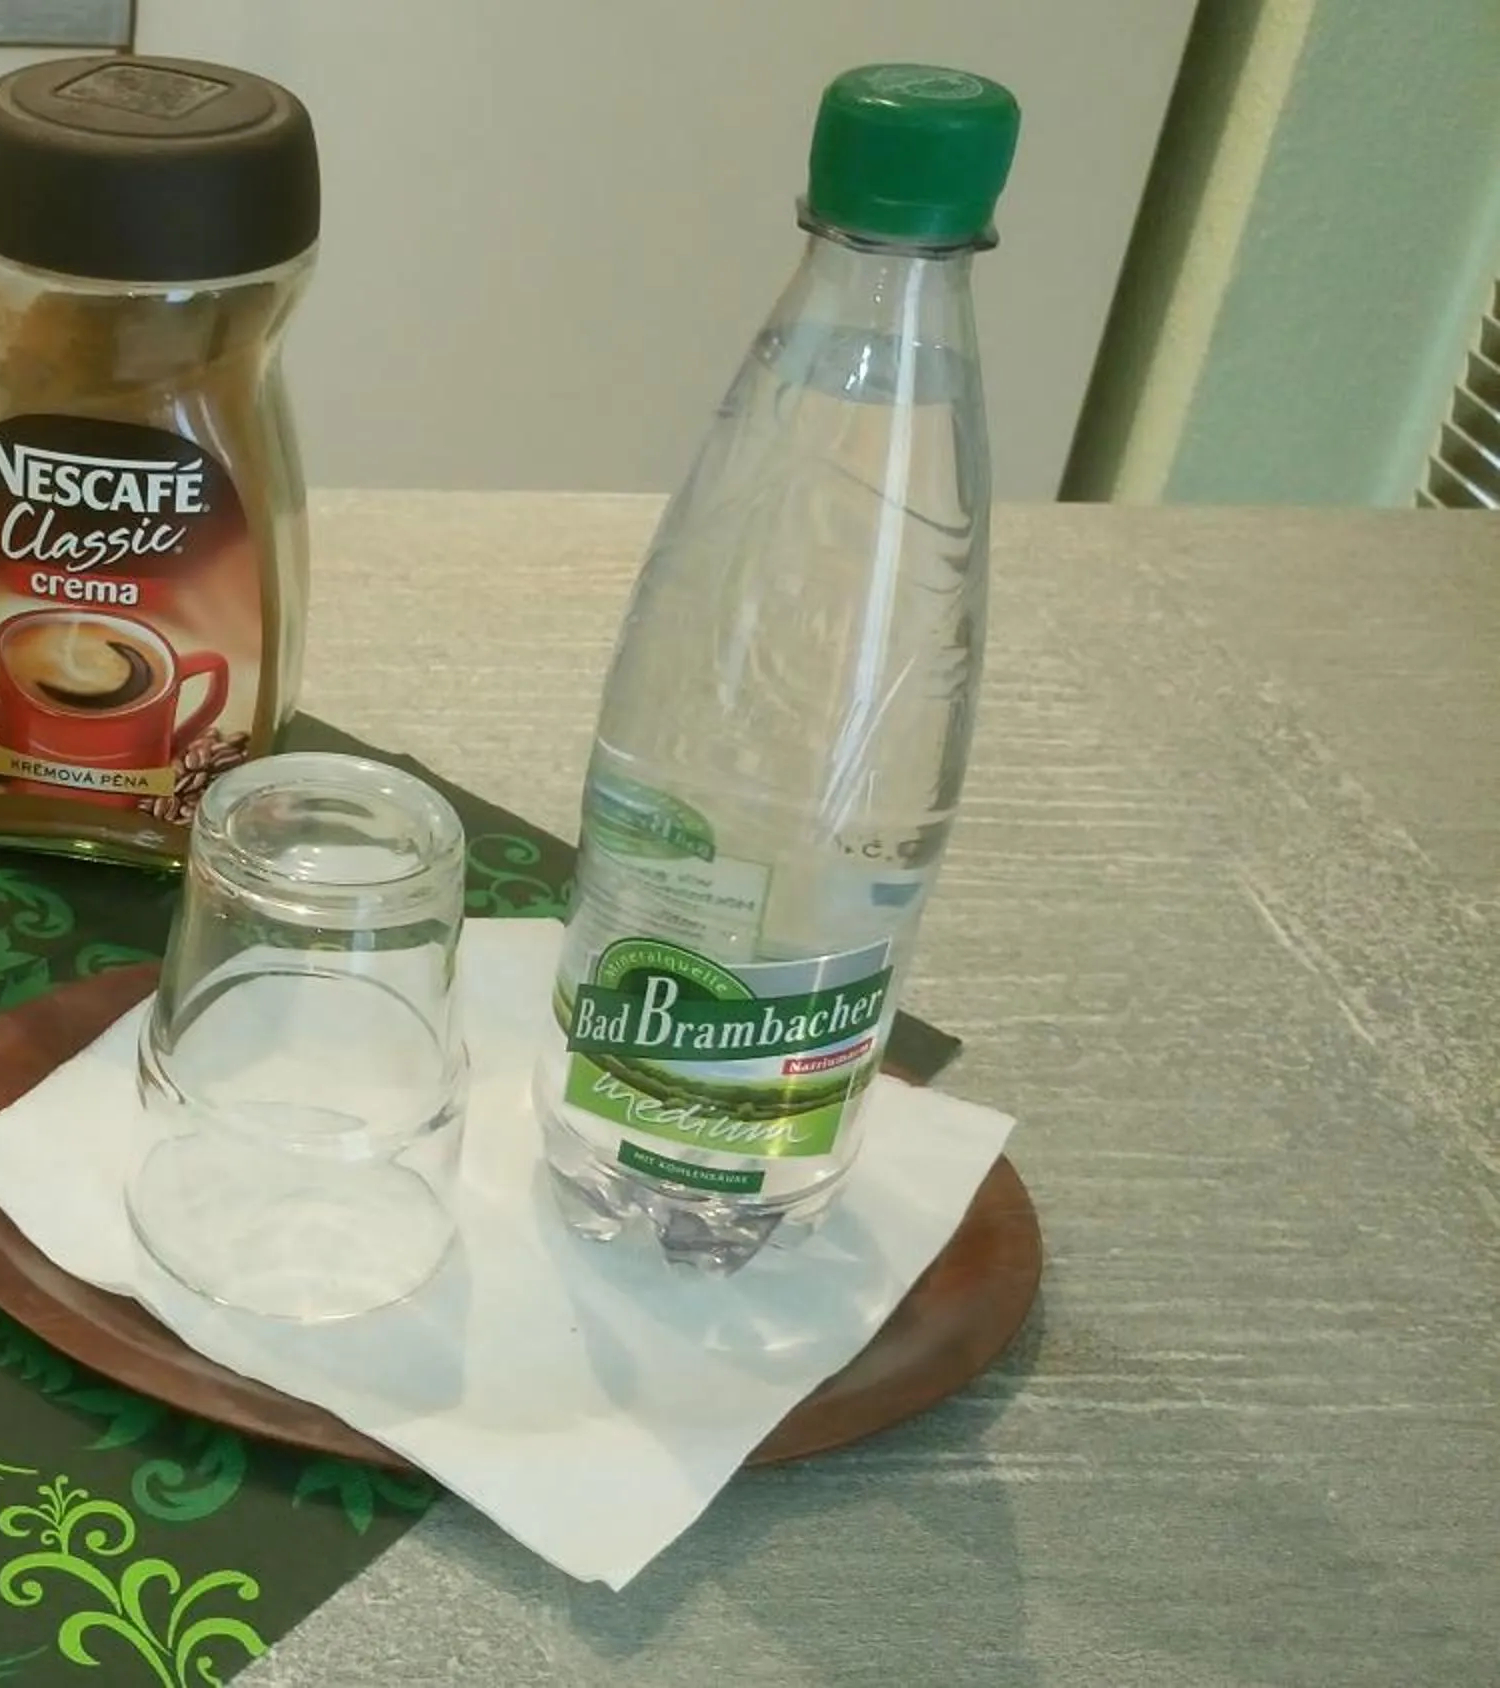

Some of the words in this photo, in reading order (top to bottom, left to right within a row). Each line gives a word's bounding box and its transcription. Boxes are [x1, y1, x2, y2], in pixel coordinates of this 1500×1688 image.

[0, 502, 187, 572] Classic
[30, 571, 139, 606] crema
[576, 998, 631, 1043] Bad
[634, 976, 883, 1049] Brambacher
[592, 1071, 812, 1144] medium
